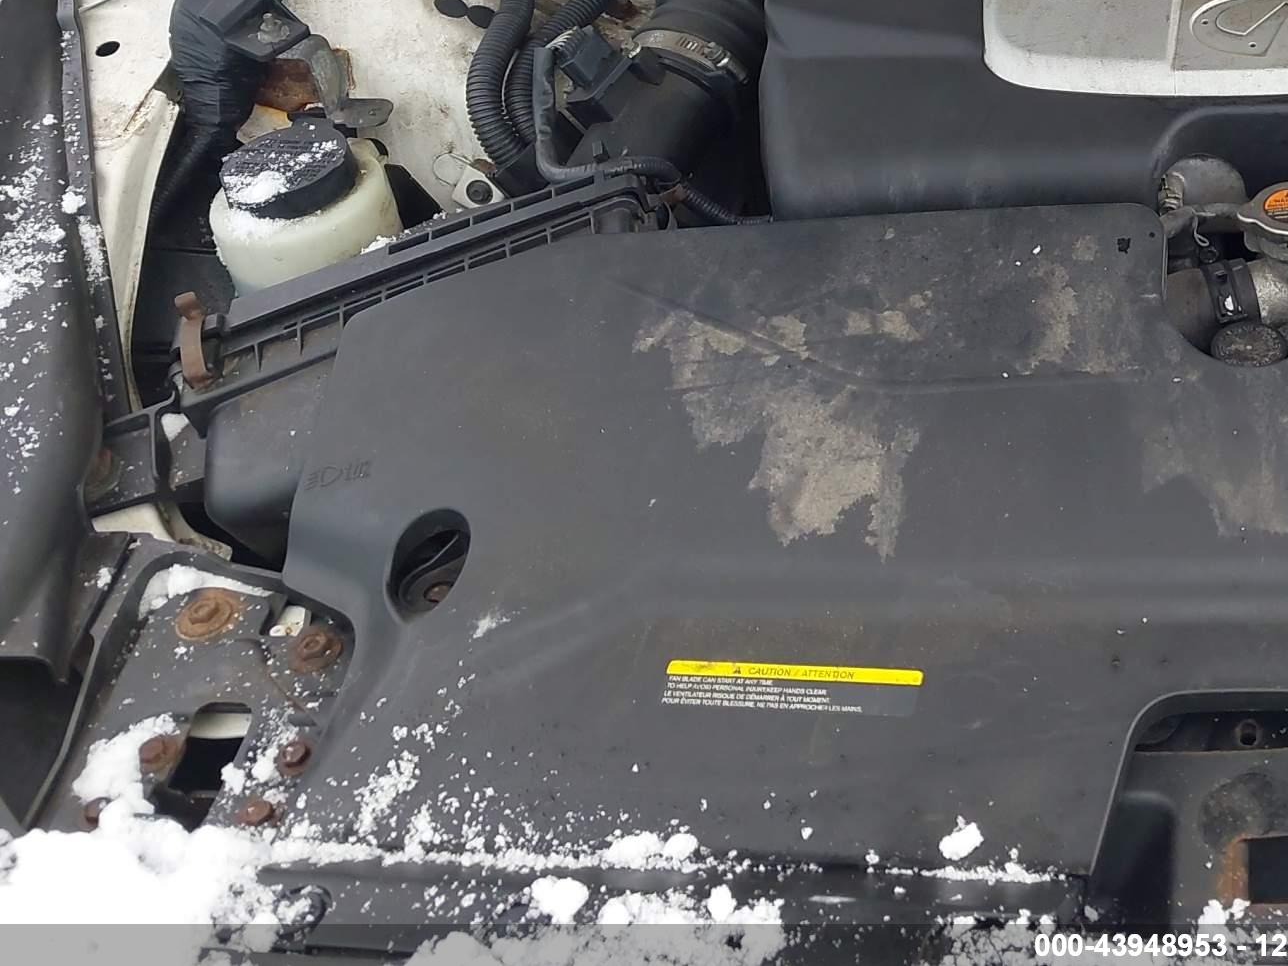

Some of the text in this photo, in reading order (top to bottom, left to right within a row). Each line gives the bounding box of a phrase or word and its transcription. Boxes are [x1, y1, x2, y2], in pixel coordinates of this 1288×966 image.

[748, 666, 792, 677] CAUTION
[801, 669, 855, 679] ATTENTION
[712, 684, 744, 692] PERSONAL
